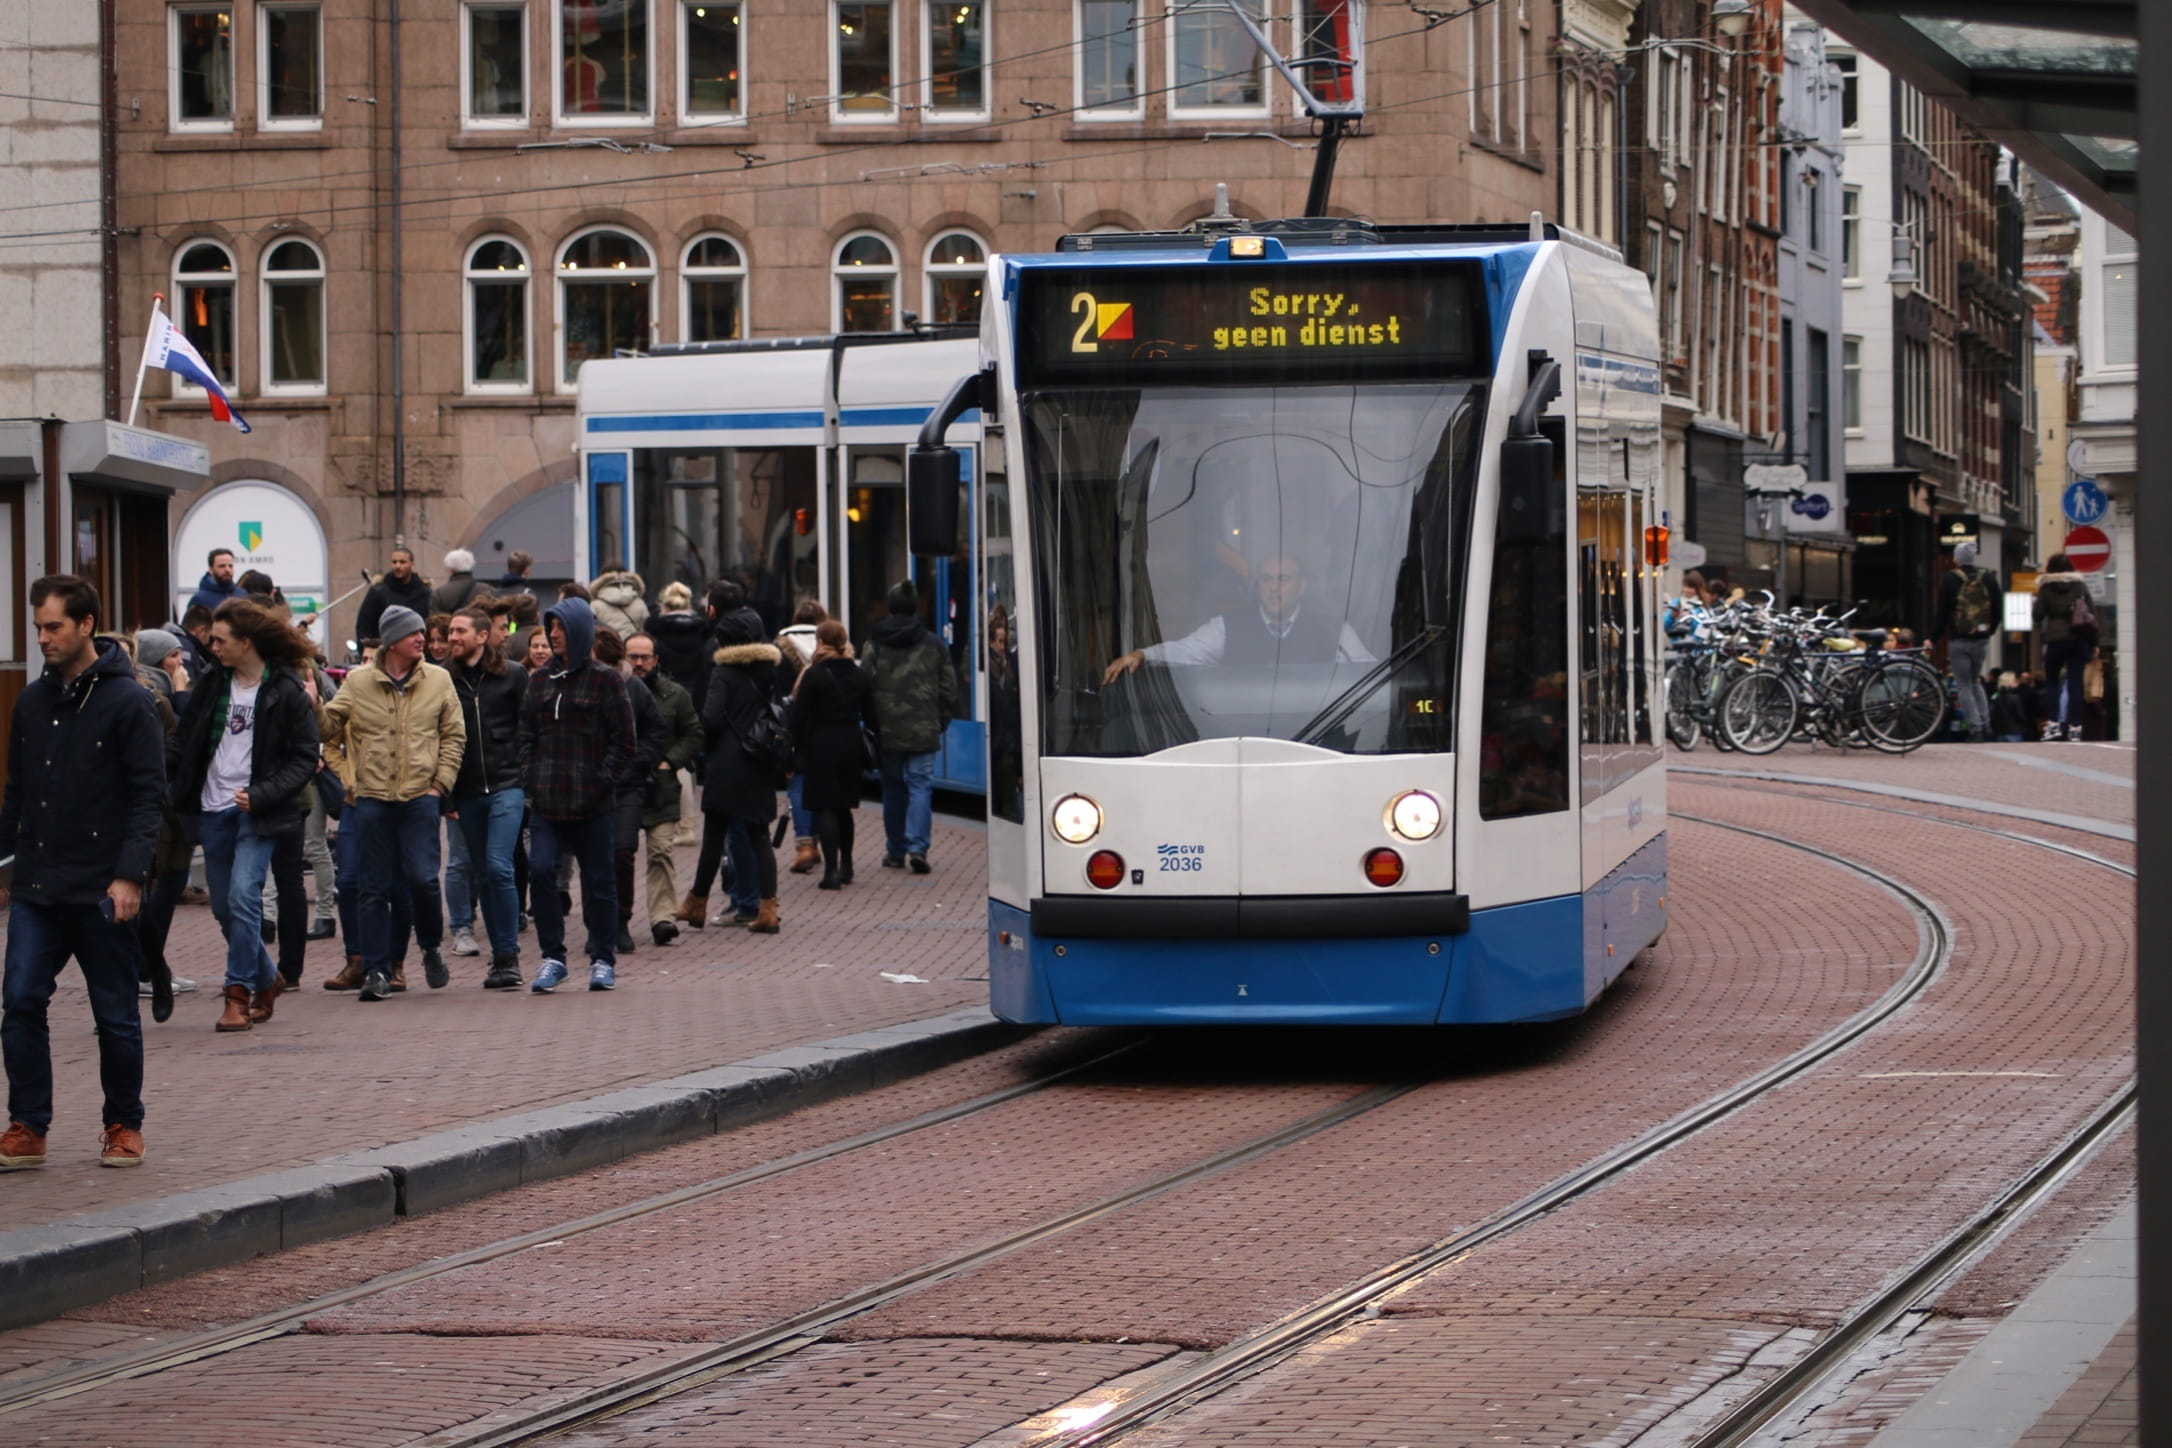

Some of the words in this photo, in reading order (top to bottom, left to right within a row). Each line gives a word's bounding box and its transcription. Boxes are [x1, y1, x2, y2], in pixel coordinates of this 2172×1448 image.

[1250, 288, 1358, 316] Sorry,
[1071, 292, 1098, 352] 2
[1213, 326, 1287, 350] geen
[1300, 316, 1400, 346] dienst
[1180, 845, 1205, 854] GVB
[1160, 857, 1202, 871] 2036
